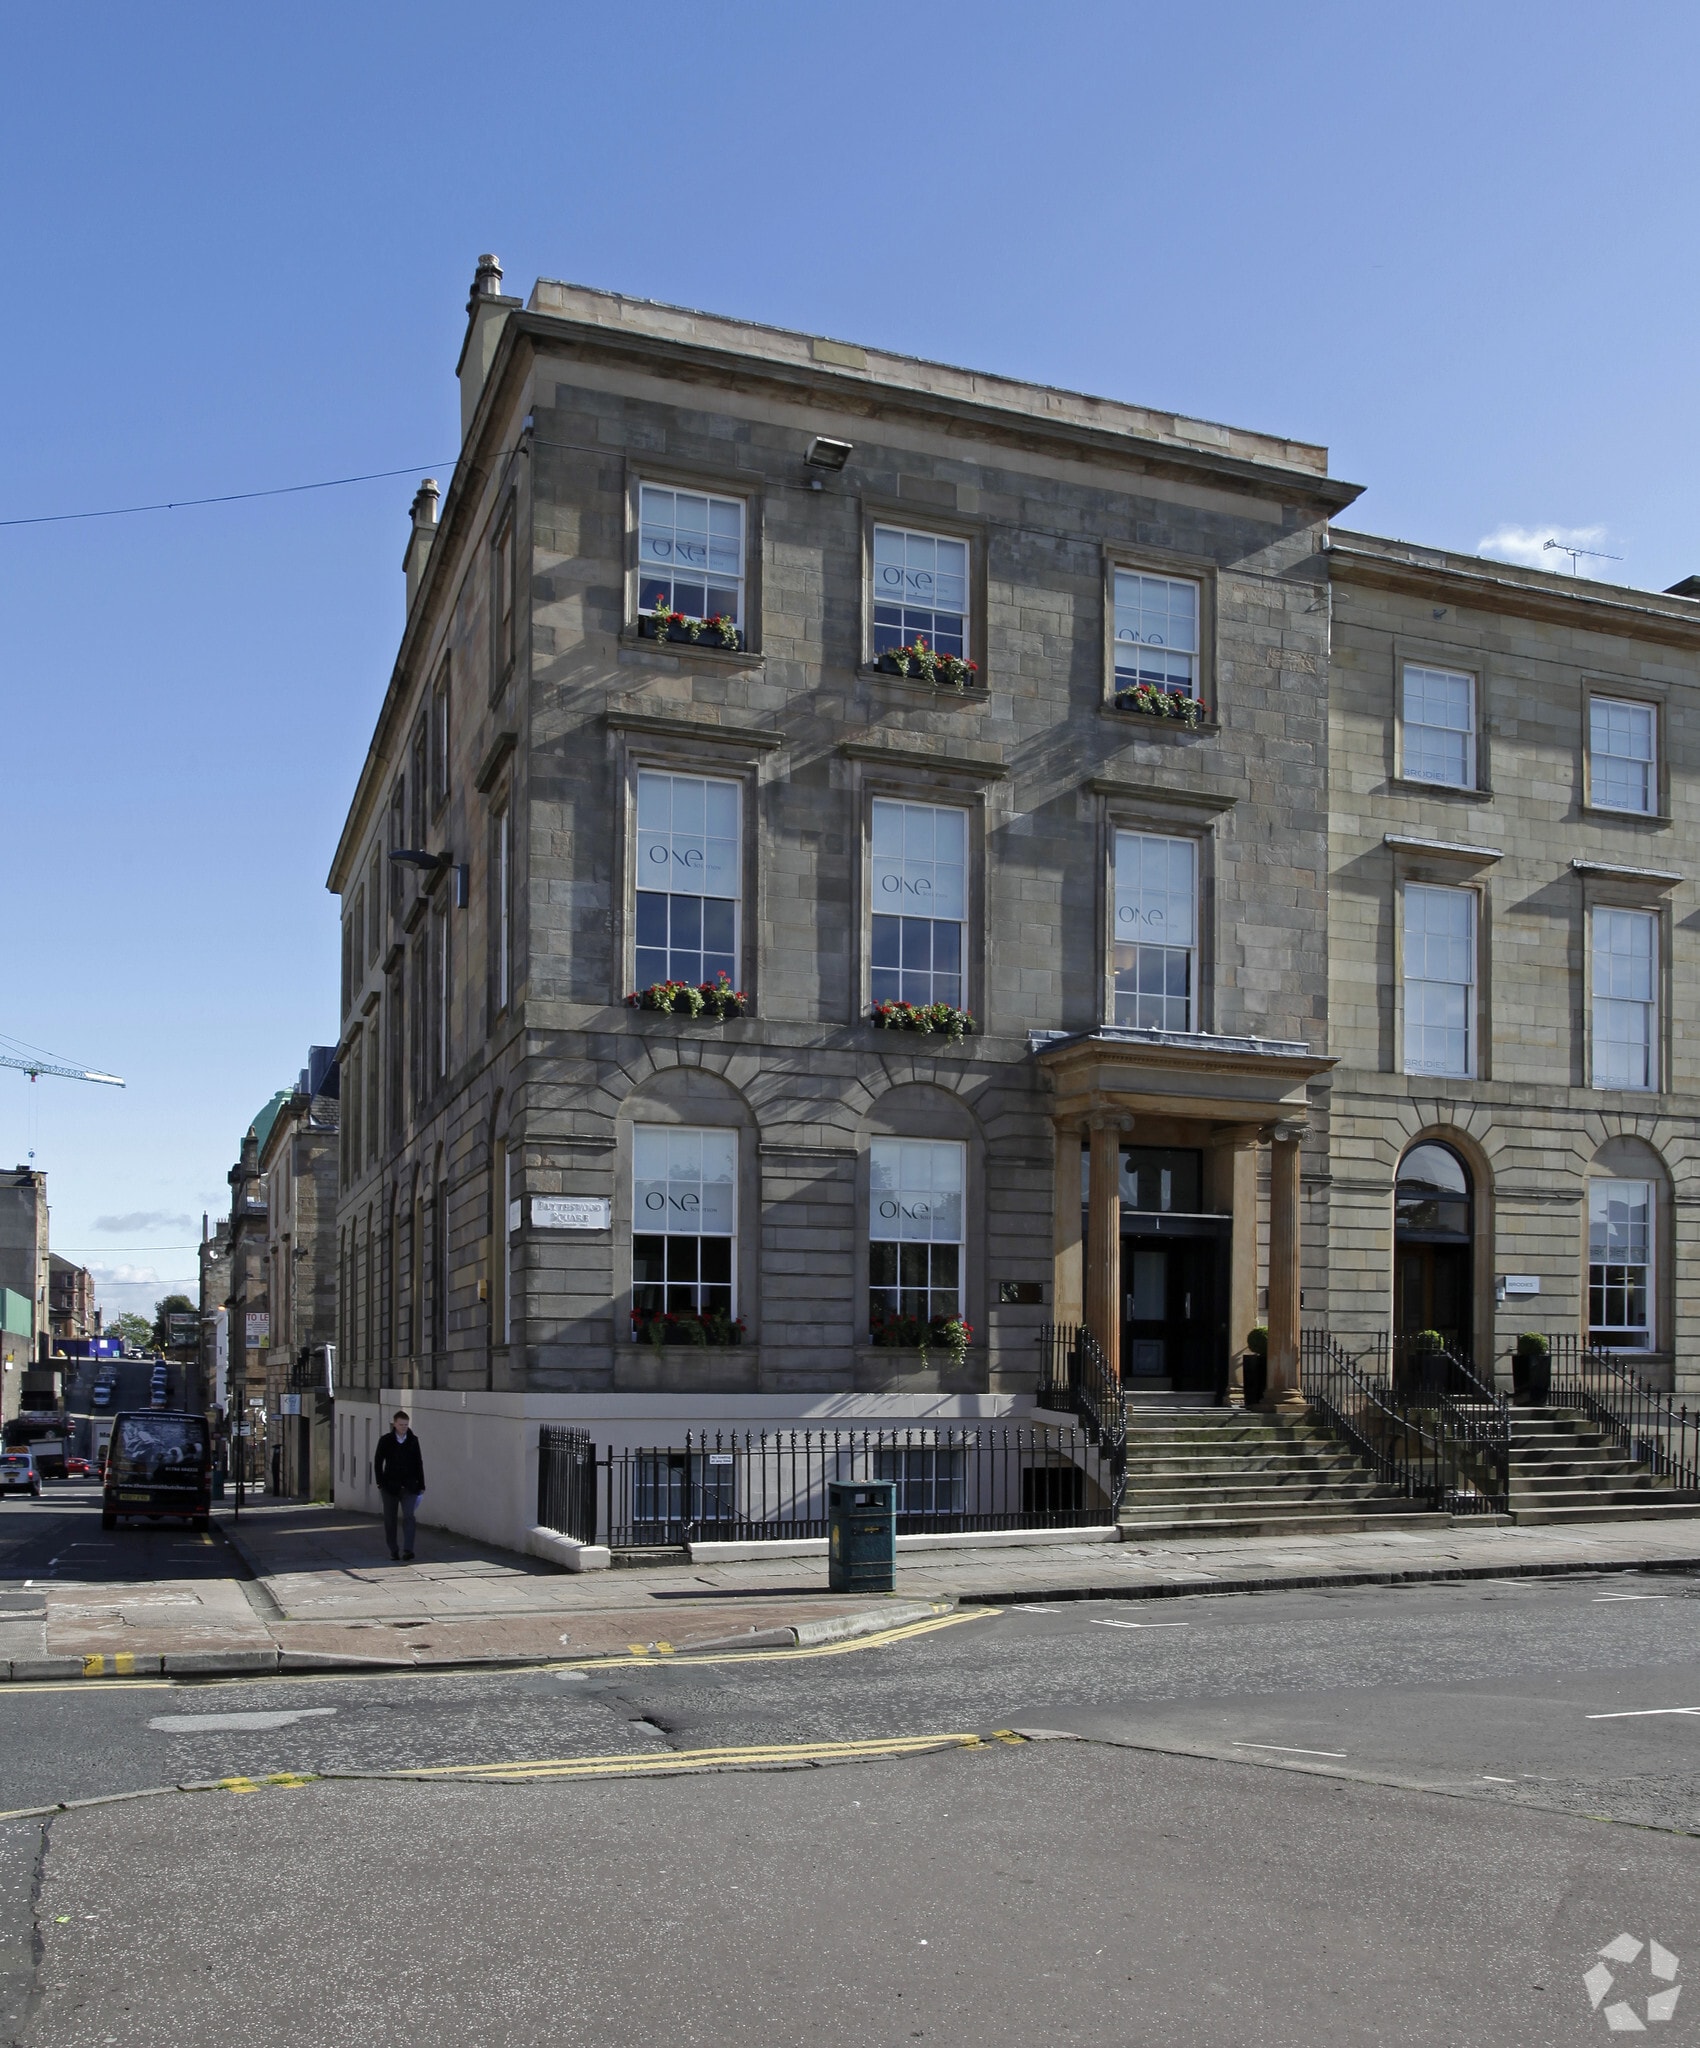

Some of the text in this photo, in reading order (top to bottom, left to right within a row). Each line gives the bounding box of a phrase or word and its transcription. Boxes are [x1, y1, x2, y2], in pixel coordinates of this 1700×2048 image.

[550, 1213, 590, 1222] SQUARE
[246, 1313, 269, 1321] TO LE
